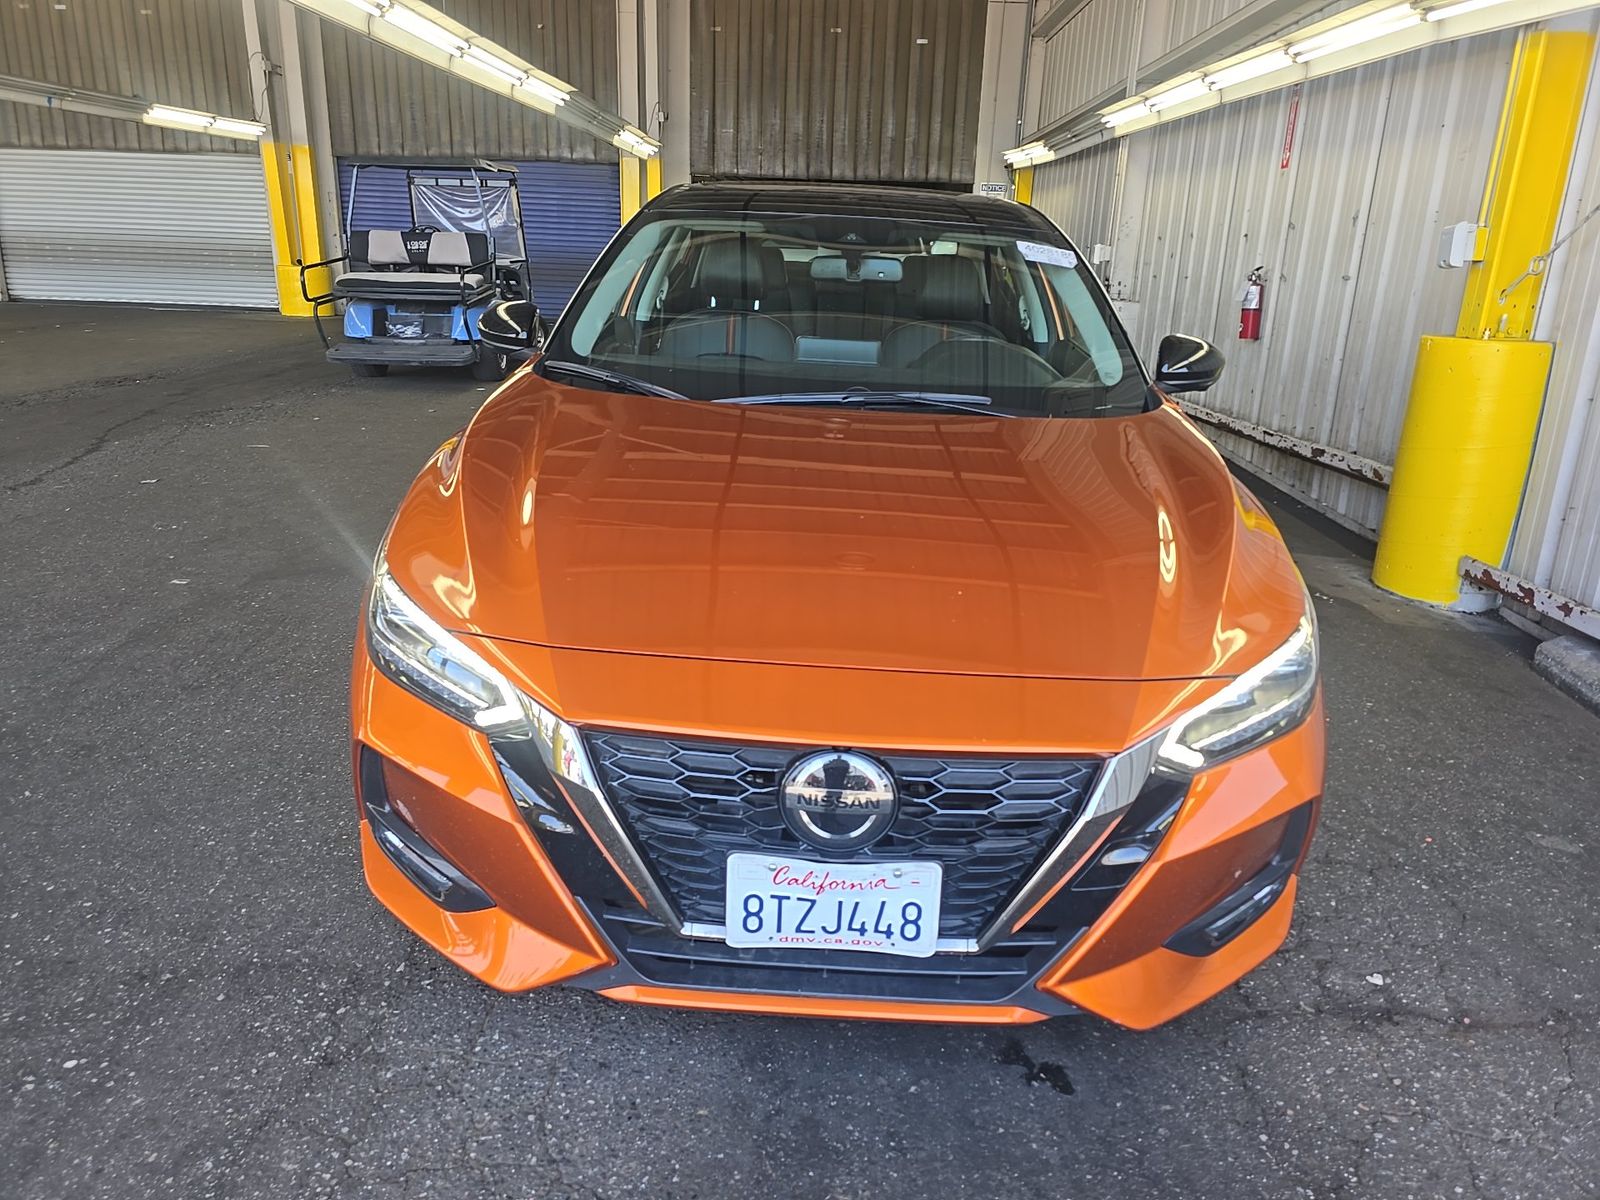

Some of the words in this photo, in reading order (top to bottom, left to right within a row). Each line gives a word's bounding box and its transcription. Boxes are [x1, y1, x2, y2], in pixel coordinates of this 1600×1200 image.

[982, 184, 1007, 192] NOTICE
[797, 793, 880, 810] NISSAN
[772, 865, 900, 896] California
[742, 893, 922, 942] 8TZJ448
[779, 935, 884, 947] dmv.ca.gov
